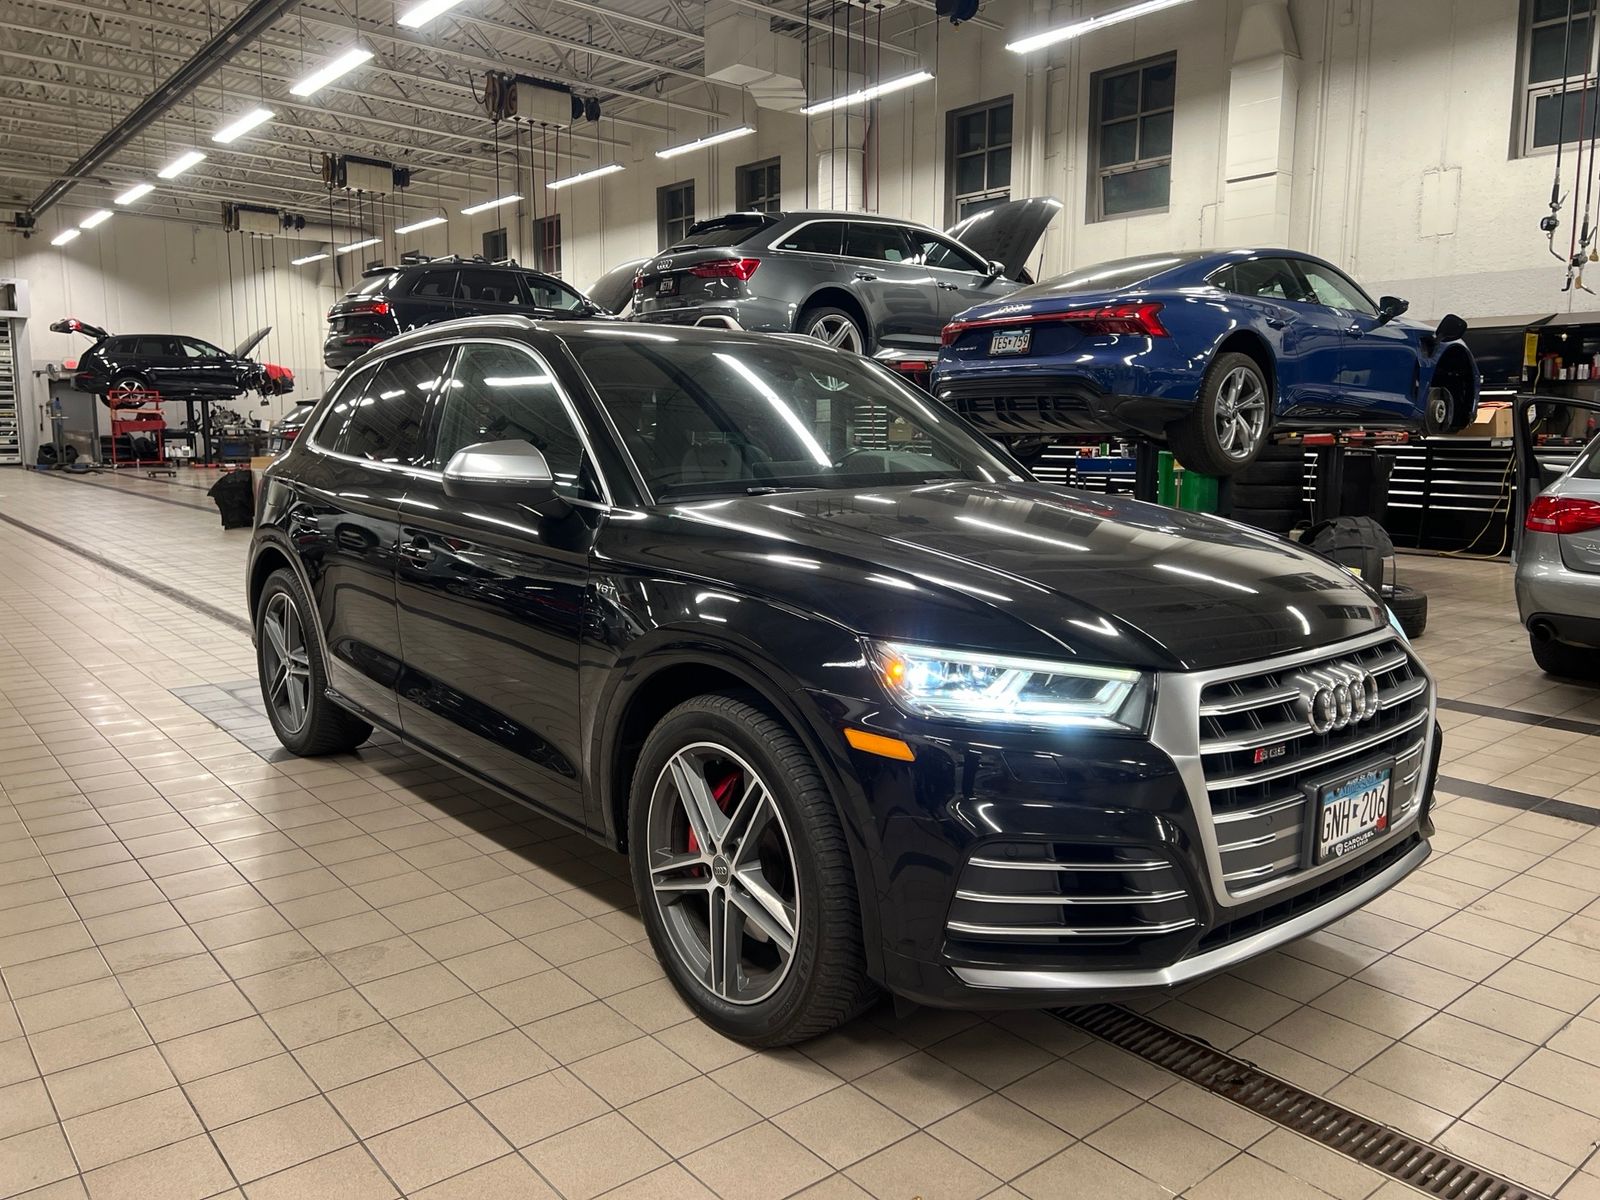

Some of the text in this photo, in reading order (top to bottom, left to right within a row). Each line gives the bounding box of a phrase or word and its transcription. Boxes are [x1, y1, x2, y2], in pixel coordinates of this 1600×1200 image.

[993, 335, 1029, 350] TES 759
[595, 582, 616, 595] V6T
[1321, 798, 1351, 844] GNH
[1360, 785, 1386, 828] 206
[1344, 830, 1374, 848] CAROUSEL
